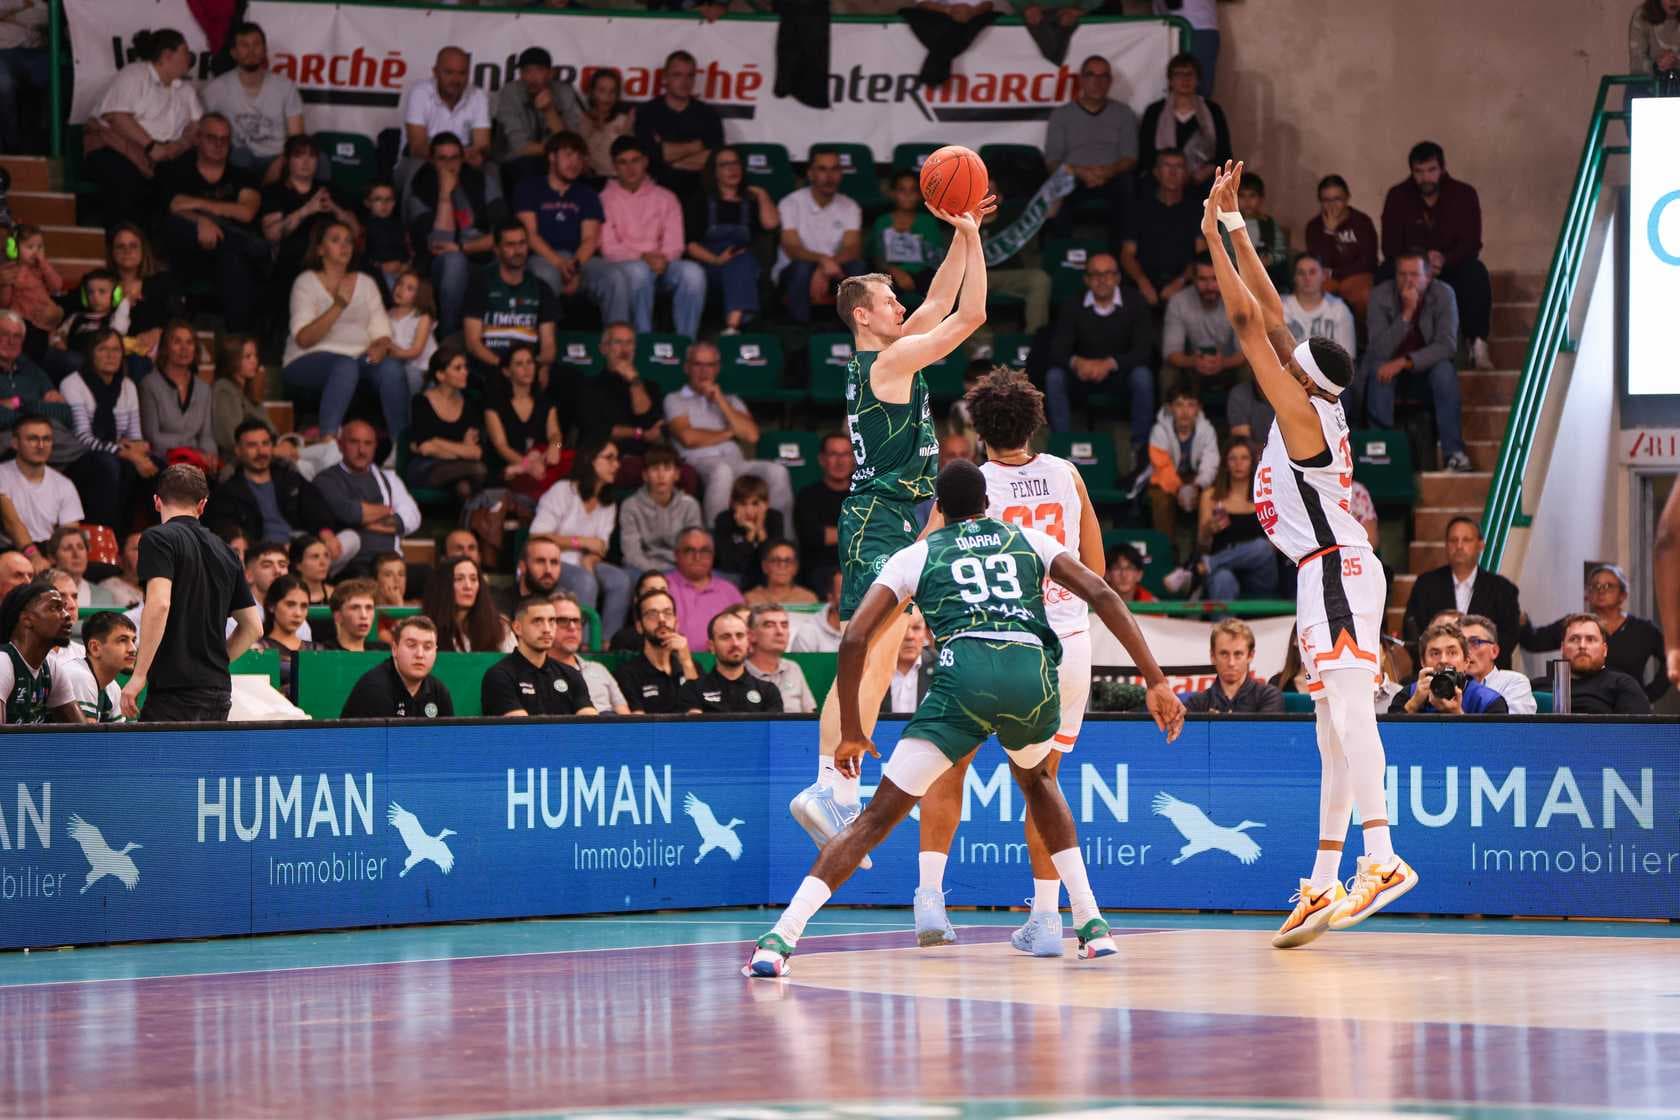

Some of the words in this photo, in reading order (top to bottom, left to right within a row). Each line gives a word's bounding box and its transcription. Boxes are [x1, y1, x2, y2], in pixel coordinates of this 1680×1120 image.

[1009, 478, 1050, 498] PENDA
[955, 533, 1002, 550] DIARRA
[951, 554, 1023, 604] 93
[1343, 557, 1363, 577] 35
[939, 649, 954, 667] 93
[197, 772, 374, 843] HUMAN
[507, 764, 672, 830] HUMAN
[573, 838, 684, 870] Immobilier
[959, 836, 1152, 866] Immilier
[1471, 841, 1680, 874] Immobilier
[269, 851, 388, 886] Immobilier
